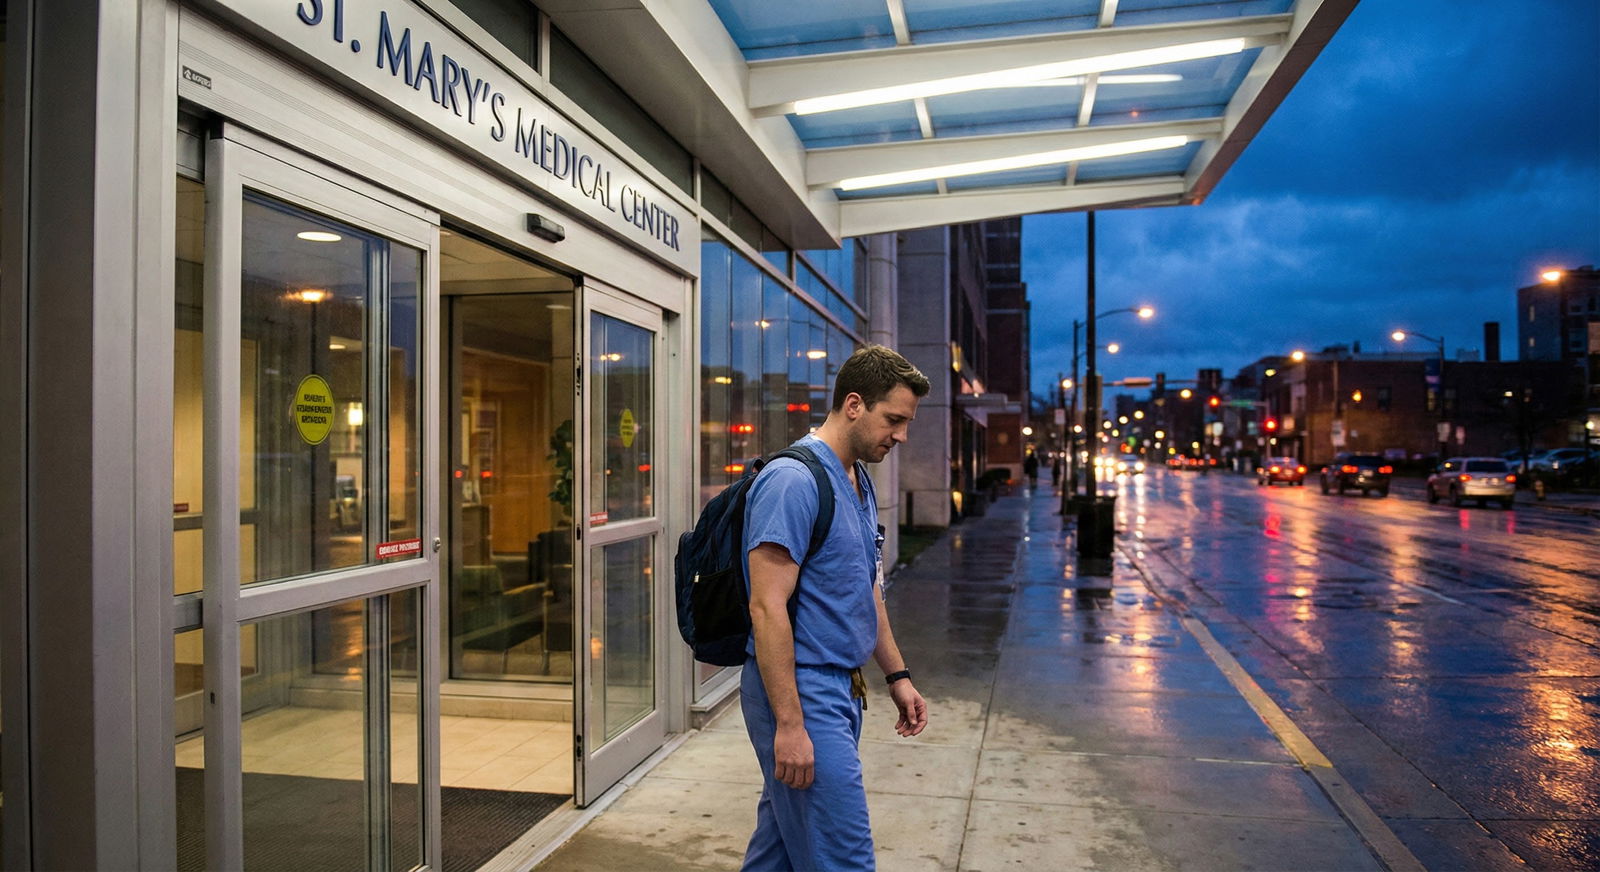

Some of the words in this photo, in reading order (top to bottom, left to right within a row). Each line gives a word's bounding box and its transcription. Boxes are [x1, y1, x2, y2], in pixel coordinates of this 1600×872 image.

[377, 11, 505, 142] MARY'S
[515, 108, 616, 212] MEDICAL
[621, 184, 680, 251] CENTER
